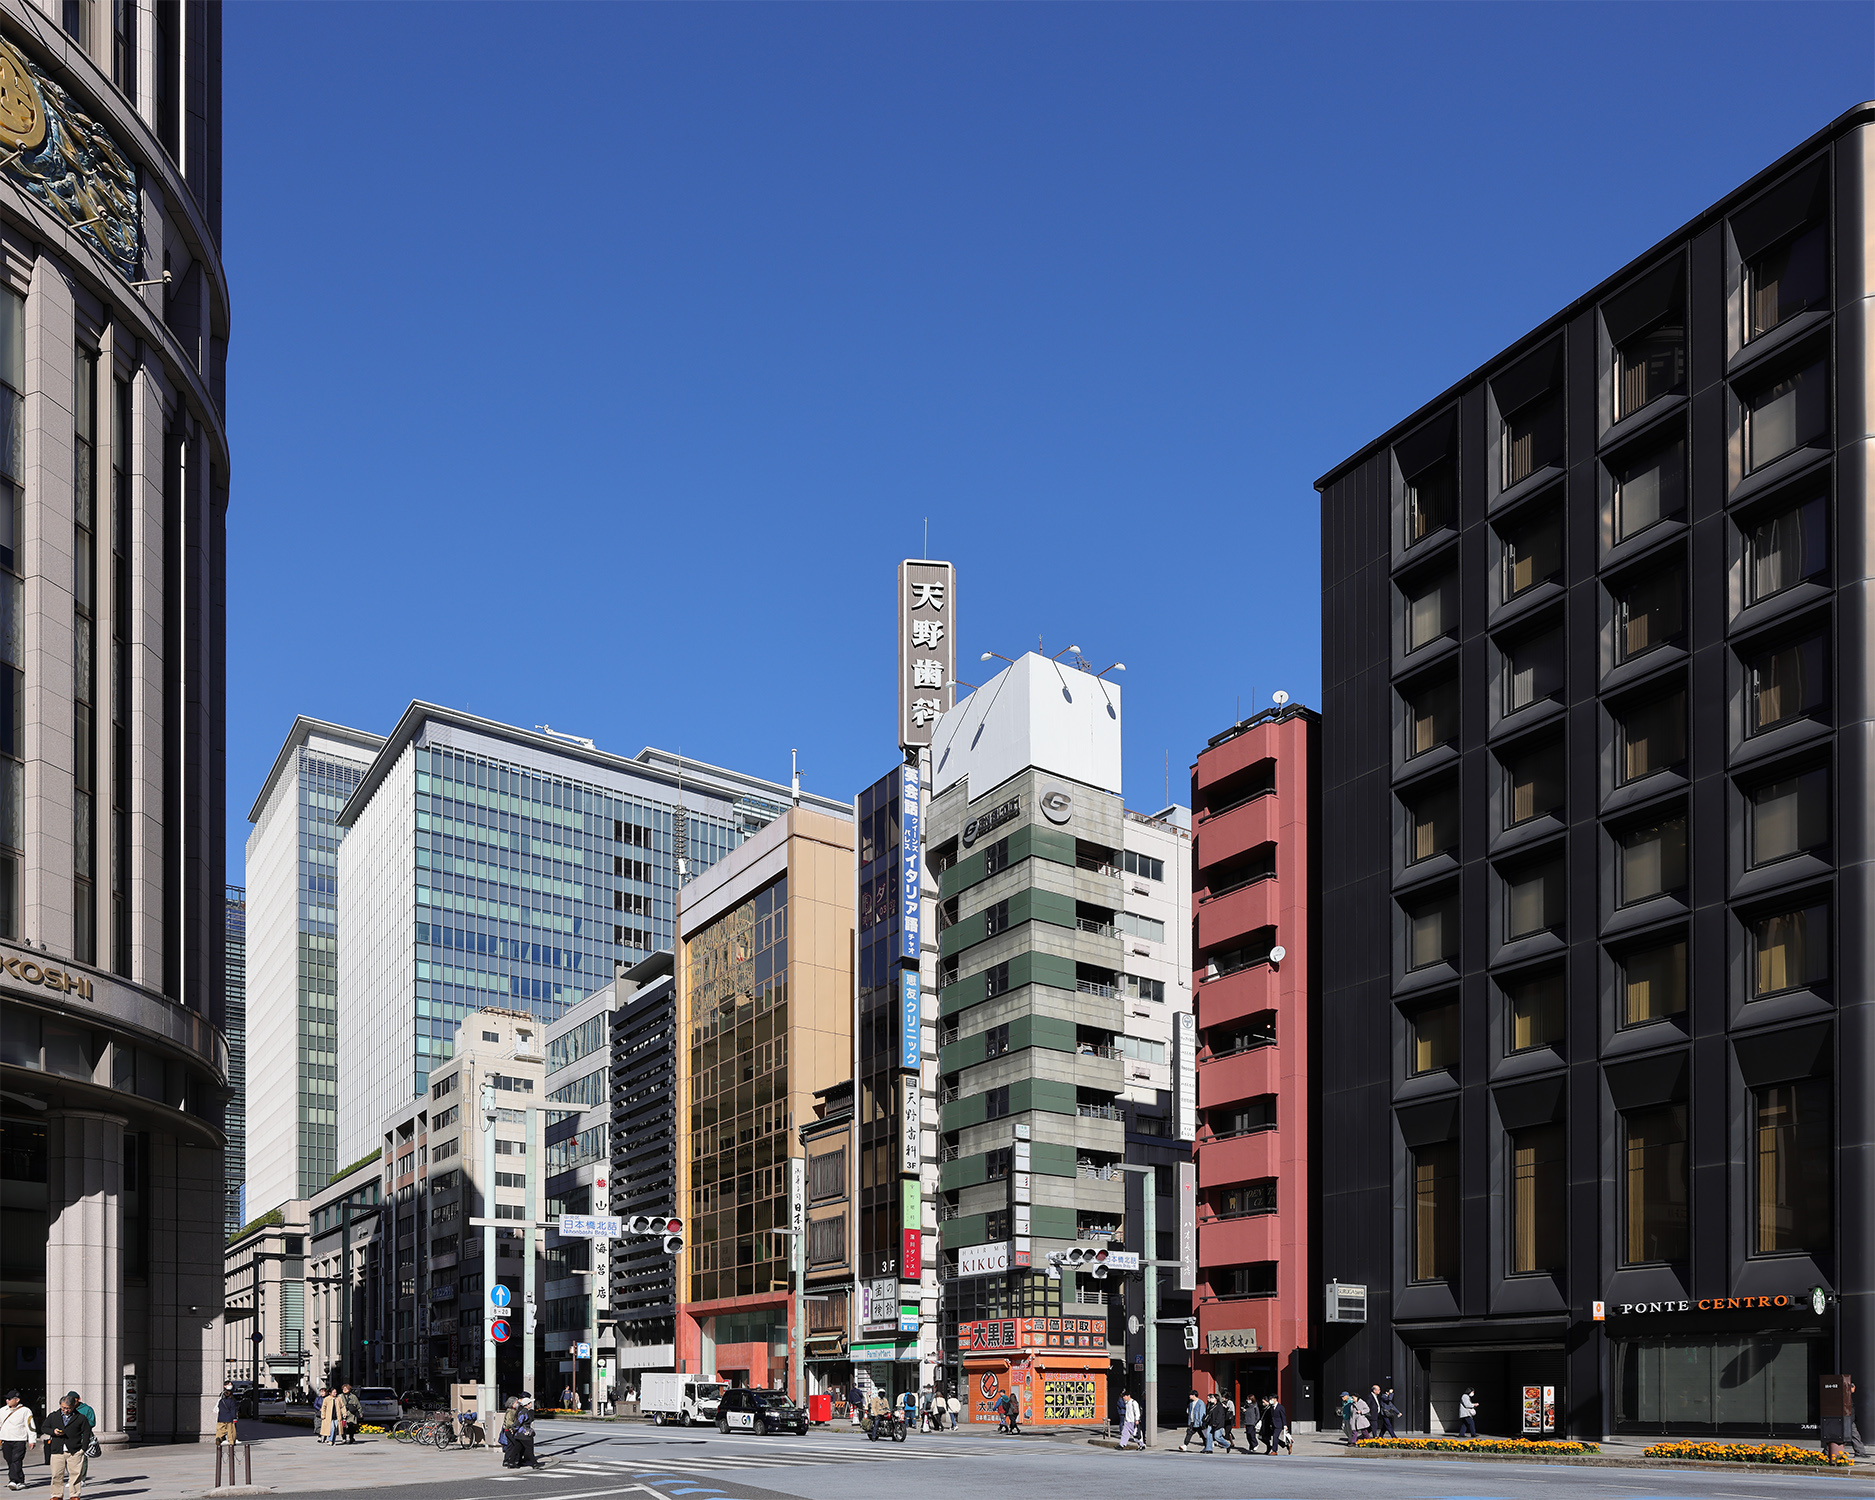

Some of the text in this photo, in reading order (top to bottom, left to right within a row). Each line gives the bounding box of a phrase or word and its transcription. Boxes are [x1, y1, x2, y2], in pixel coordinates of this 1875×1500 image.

[911, 580, 944, 728] 天野歯科
[904, 766, 919, 817] 英会話
[904, 854, 919, 933] イタリア語
[904, 974, 917, 1066] 恵友クリニック
[906, 1092, 917, 1158] 天野歯科
[564, 1220, 617, 1231] 日本橋北詰
[962, 1247, 987, 1256] HAIR
[881, 1259, 896, 1273] 3F
[1620, 1295, 1788, 1314] PONTE CENTRO
[973, 1321, 1016, 1348] 大黒屋
[1033, 1319, 1090, 1331] 高価買取
[867, 1350, 891, 1359] FamilyMart
